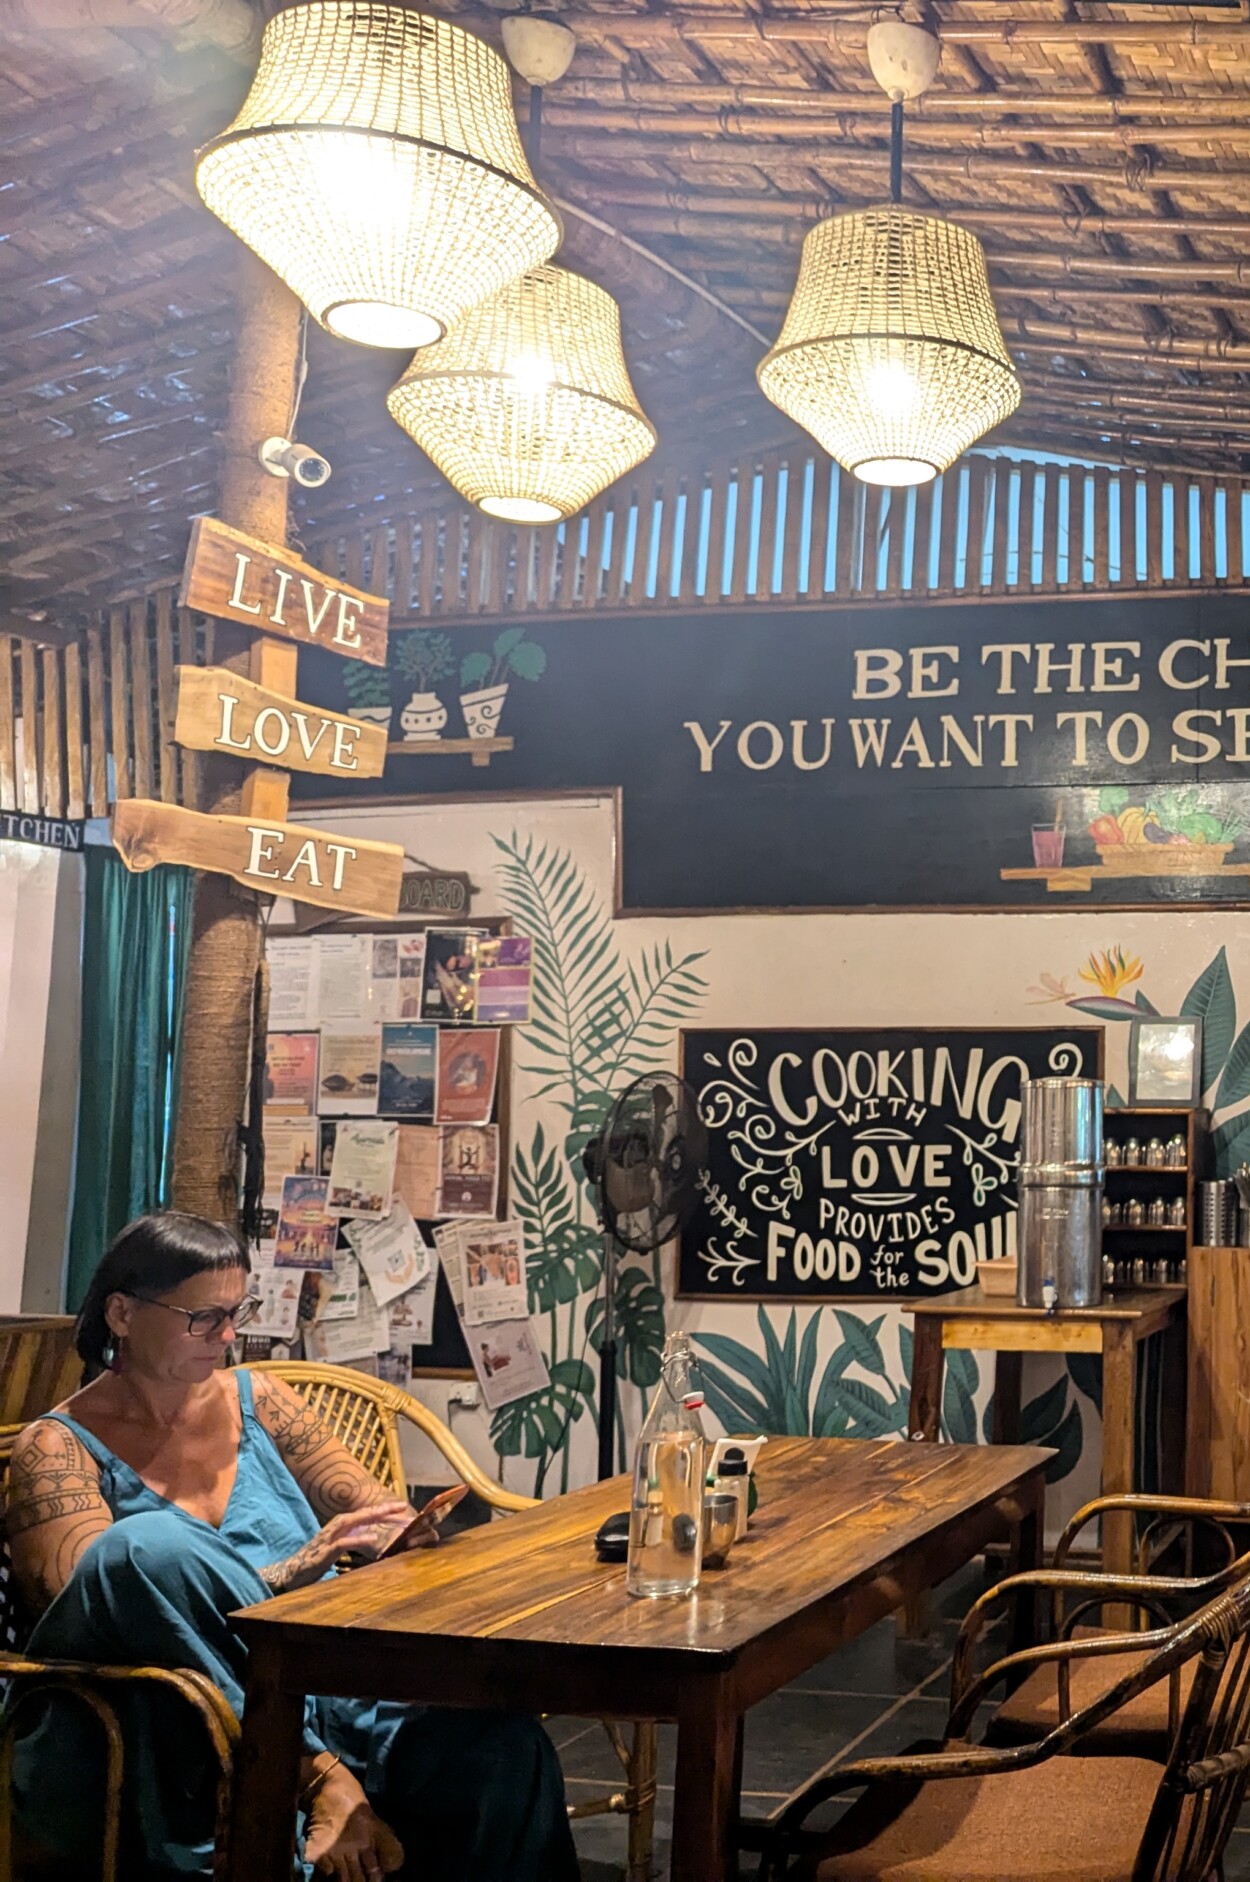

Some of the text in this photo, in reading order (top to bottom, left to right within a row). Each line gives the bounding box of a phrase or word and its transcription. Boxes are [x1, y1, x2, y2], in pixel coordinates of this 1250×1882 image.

[228, 552, 365, 649] LIVE
[851, 645, 960, 700] BE
[981, 641, 1141, 695] THE
[215, 693, 362, 771] LOVE
[683, 718, 835, 772] YOU
[849, 713, 1034, 769] WANT
[1056, 710, 1150, 766] TO
[0, 814, 80, 850] TCHEN
[244, 826, 358, 891] EAT
[767, 1046, 1030, 1143] COOKING
[836, 1098, 927, 1127] WITH
[820, 1144, 953, 1189] LOVE
[819, 1196, 956, 1243] PROVIDES
[767, 1220, 861, 1282] FOOD
[869, 1265, 910, 1289] the
[870, 1245, 905, 1267] for
